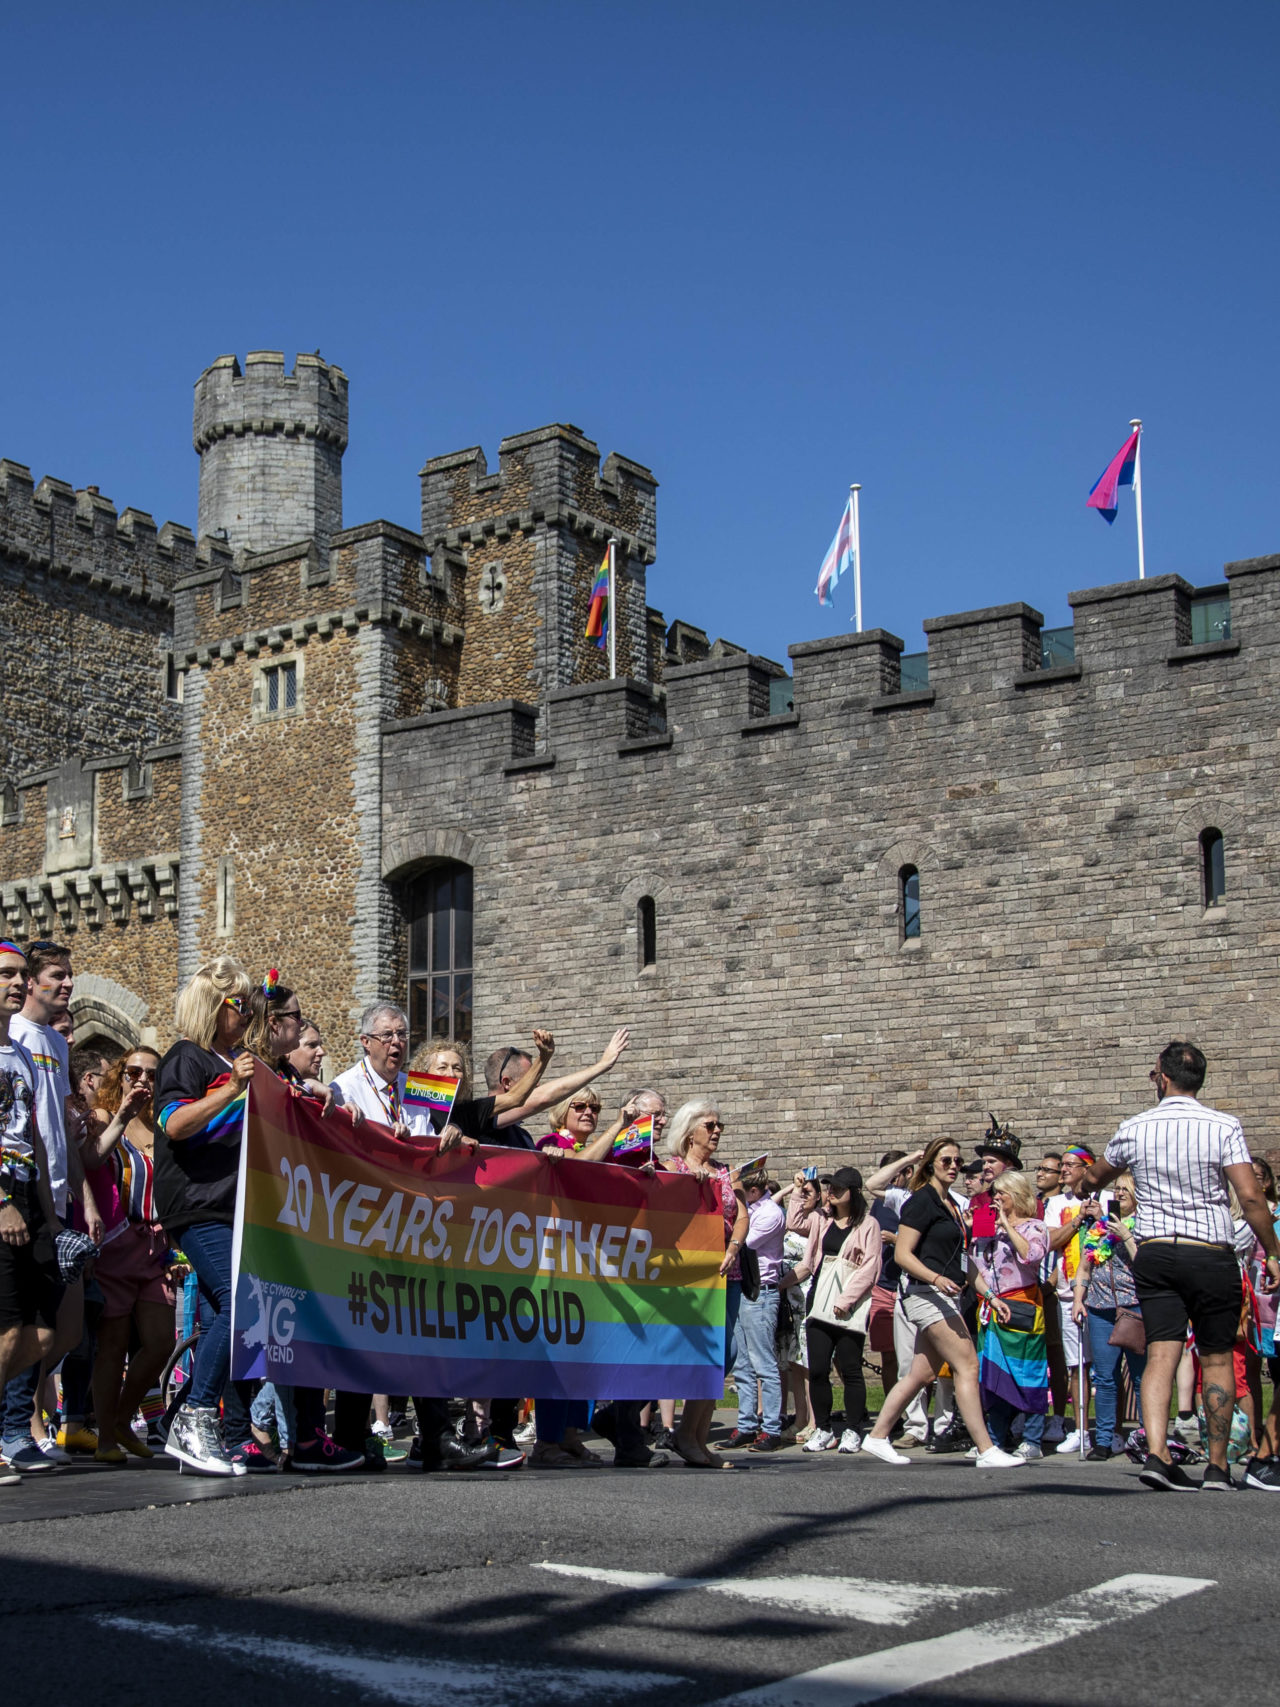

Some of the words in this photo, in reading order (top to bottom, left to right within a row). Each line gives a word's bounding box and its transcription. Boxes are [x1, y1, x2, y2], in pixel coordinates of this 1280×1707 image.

[410, 1087, 447, 1101] UNISON
[276, 1156, 313, 1233] 20
[319, 1171, 454, 1262] YEARS.
[463, 1205, 662, 1281] TOGETHER.
[348, 1269, 586, 1345] #STILLPROUD
